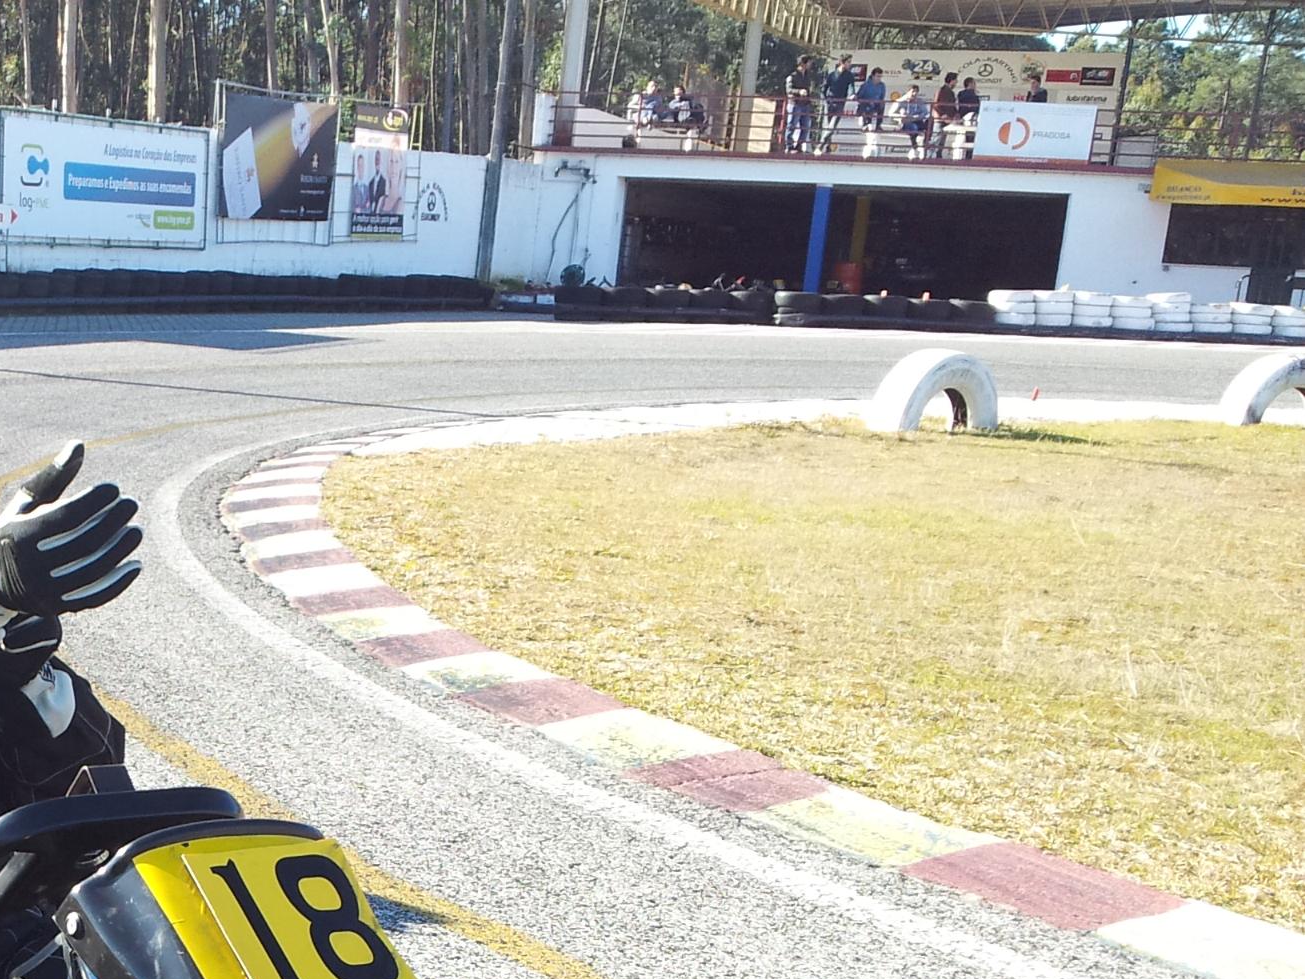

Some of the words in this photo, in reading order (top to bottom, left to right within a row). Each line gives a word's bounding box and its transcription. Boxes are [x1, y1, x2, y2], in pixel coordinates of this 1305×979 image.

[914, 60, 934, 73] 24
[68, 173, 104, 189] Preparamos
[110, 176, 139, 192] Expedimos
